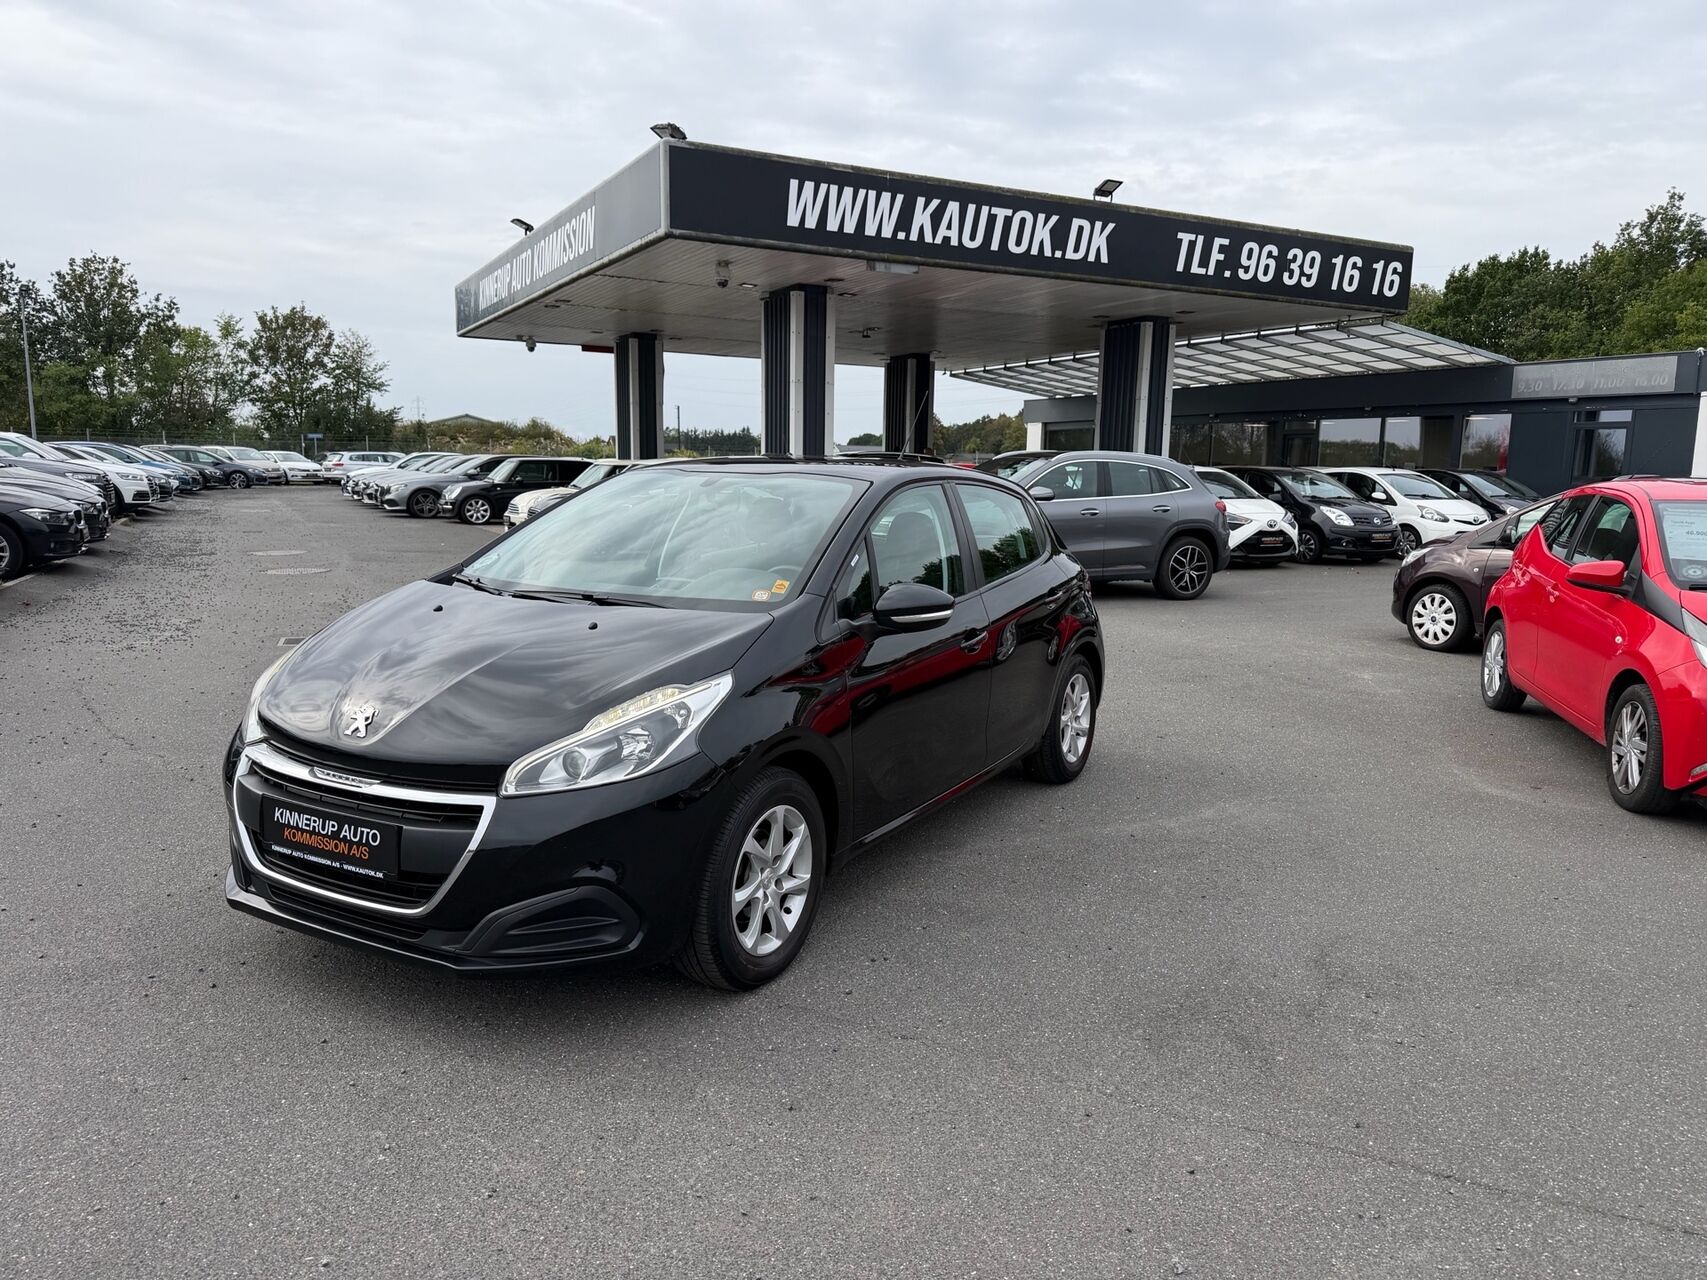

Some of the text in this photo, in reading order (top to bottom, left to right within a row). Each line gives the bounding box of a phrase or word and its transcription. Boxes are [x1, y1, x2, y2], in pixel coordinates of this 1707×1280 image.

[786, 178, 1115, 263] WWW.KAUTOK.DK
[479, 205, 596, 313] KINNERUP AUTO KOMMISSION
[1176, 231, 1403, 298] TLF. 96 39 16 16
[274, 806, 381, 846] KINNERUP AUTO
[284, 827, 369, 860] KOMMISSION A/S
[292, 850, 304, 859] AUTO
